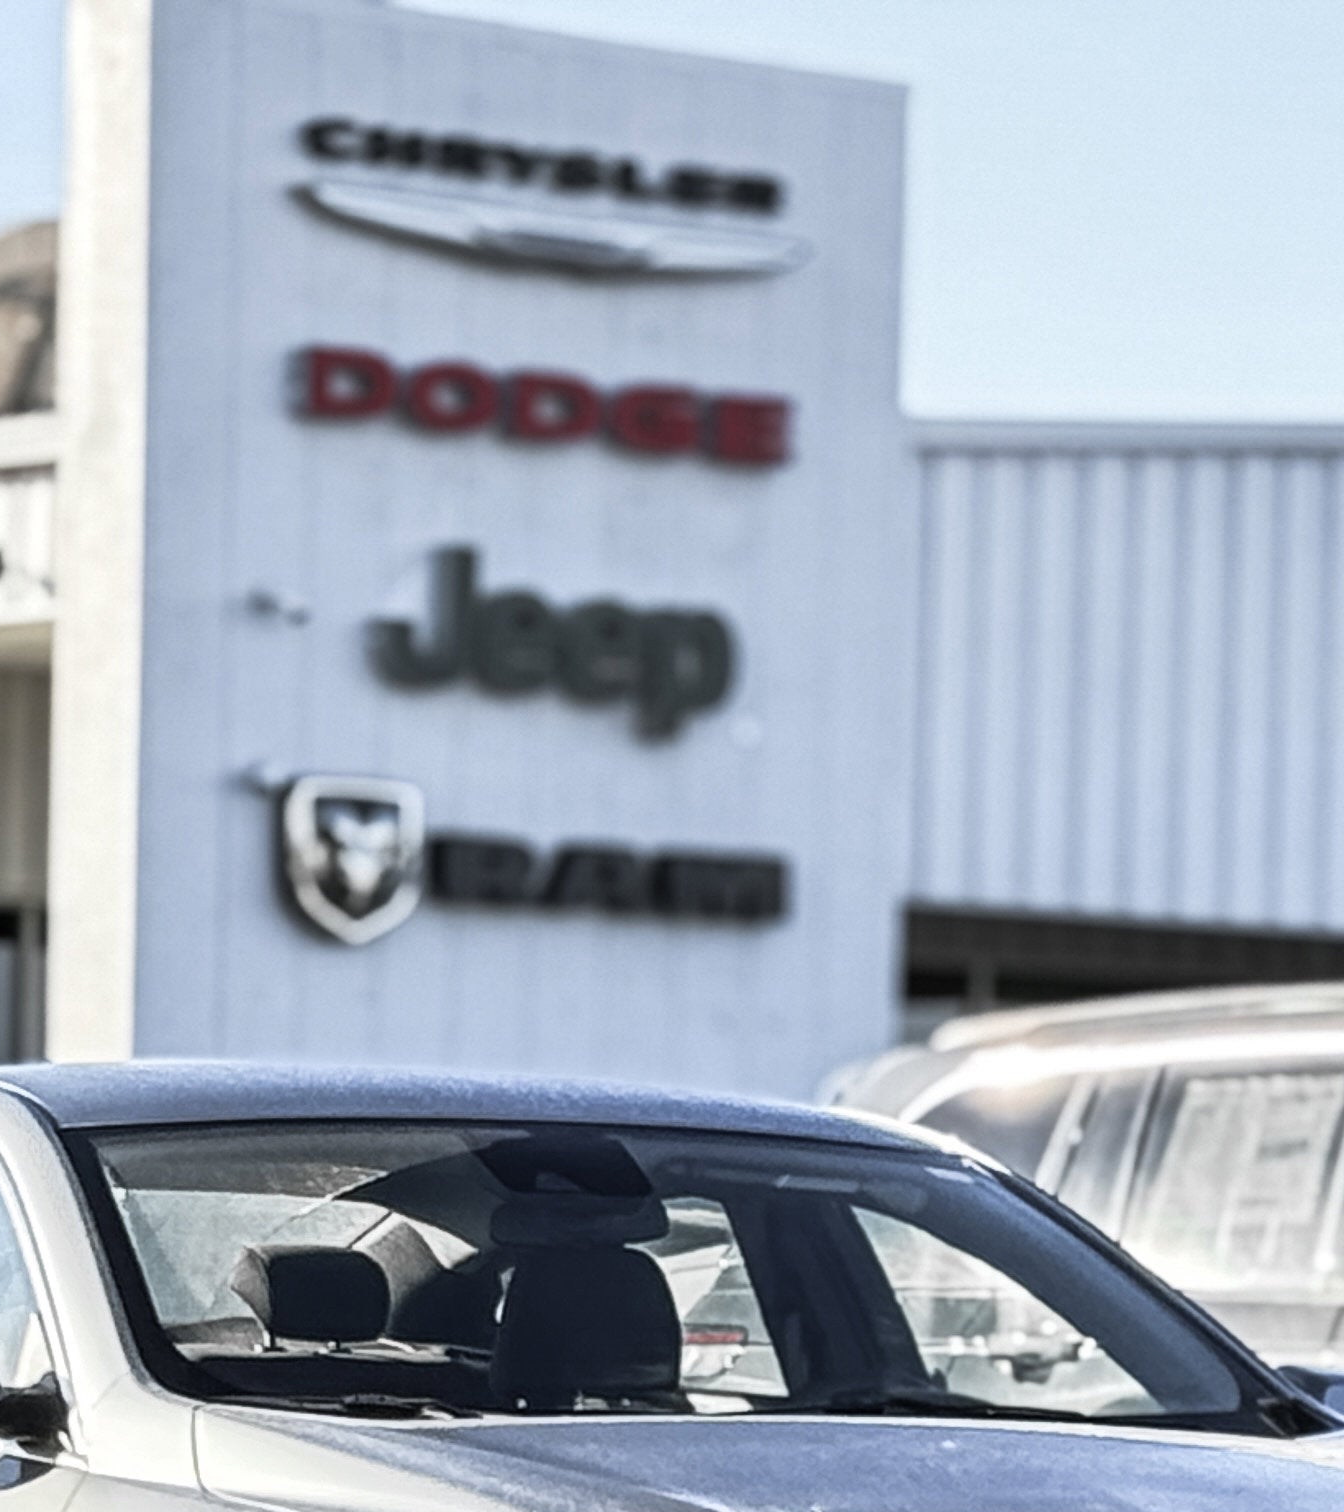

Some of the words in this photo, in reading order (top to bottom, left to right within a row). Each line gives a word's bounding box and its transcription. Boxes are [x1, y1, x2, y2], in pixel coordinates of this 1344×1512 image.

[299, 114, 784, 216] CHRYSLER
[290, 343, 794, 472] DODGE
[365, 544, 736, 746] Jeep
[428, 832, 787, 924] RAM
